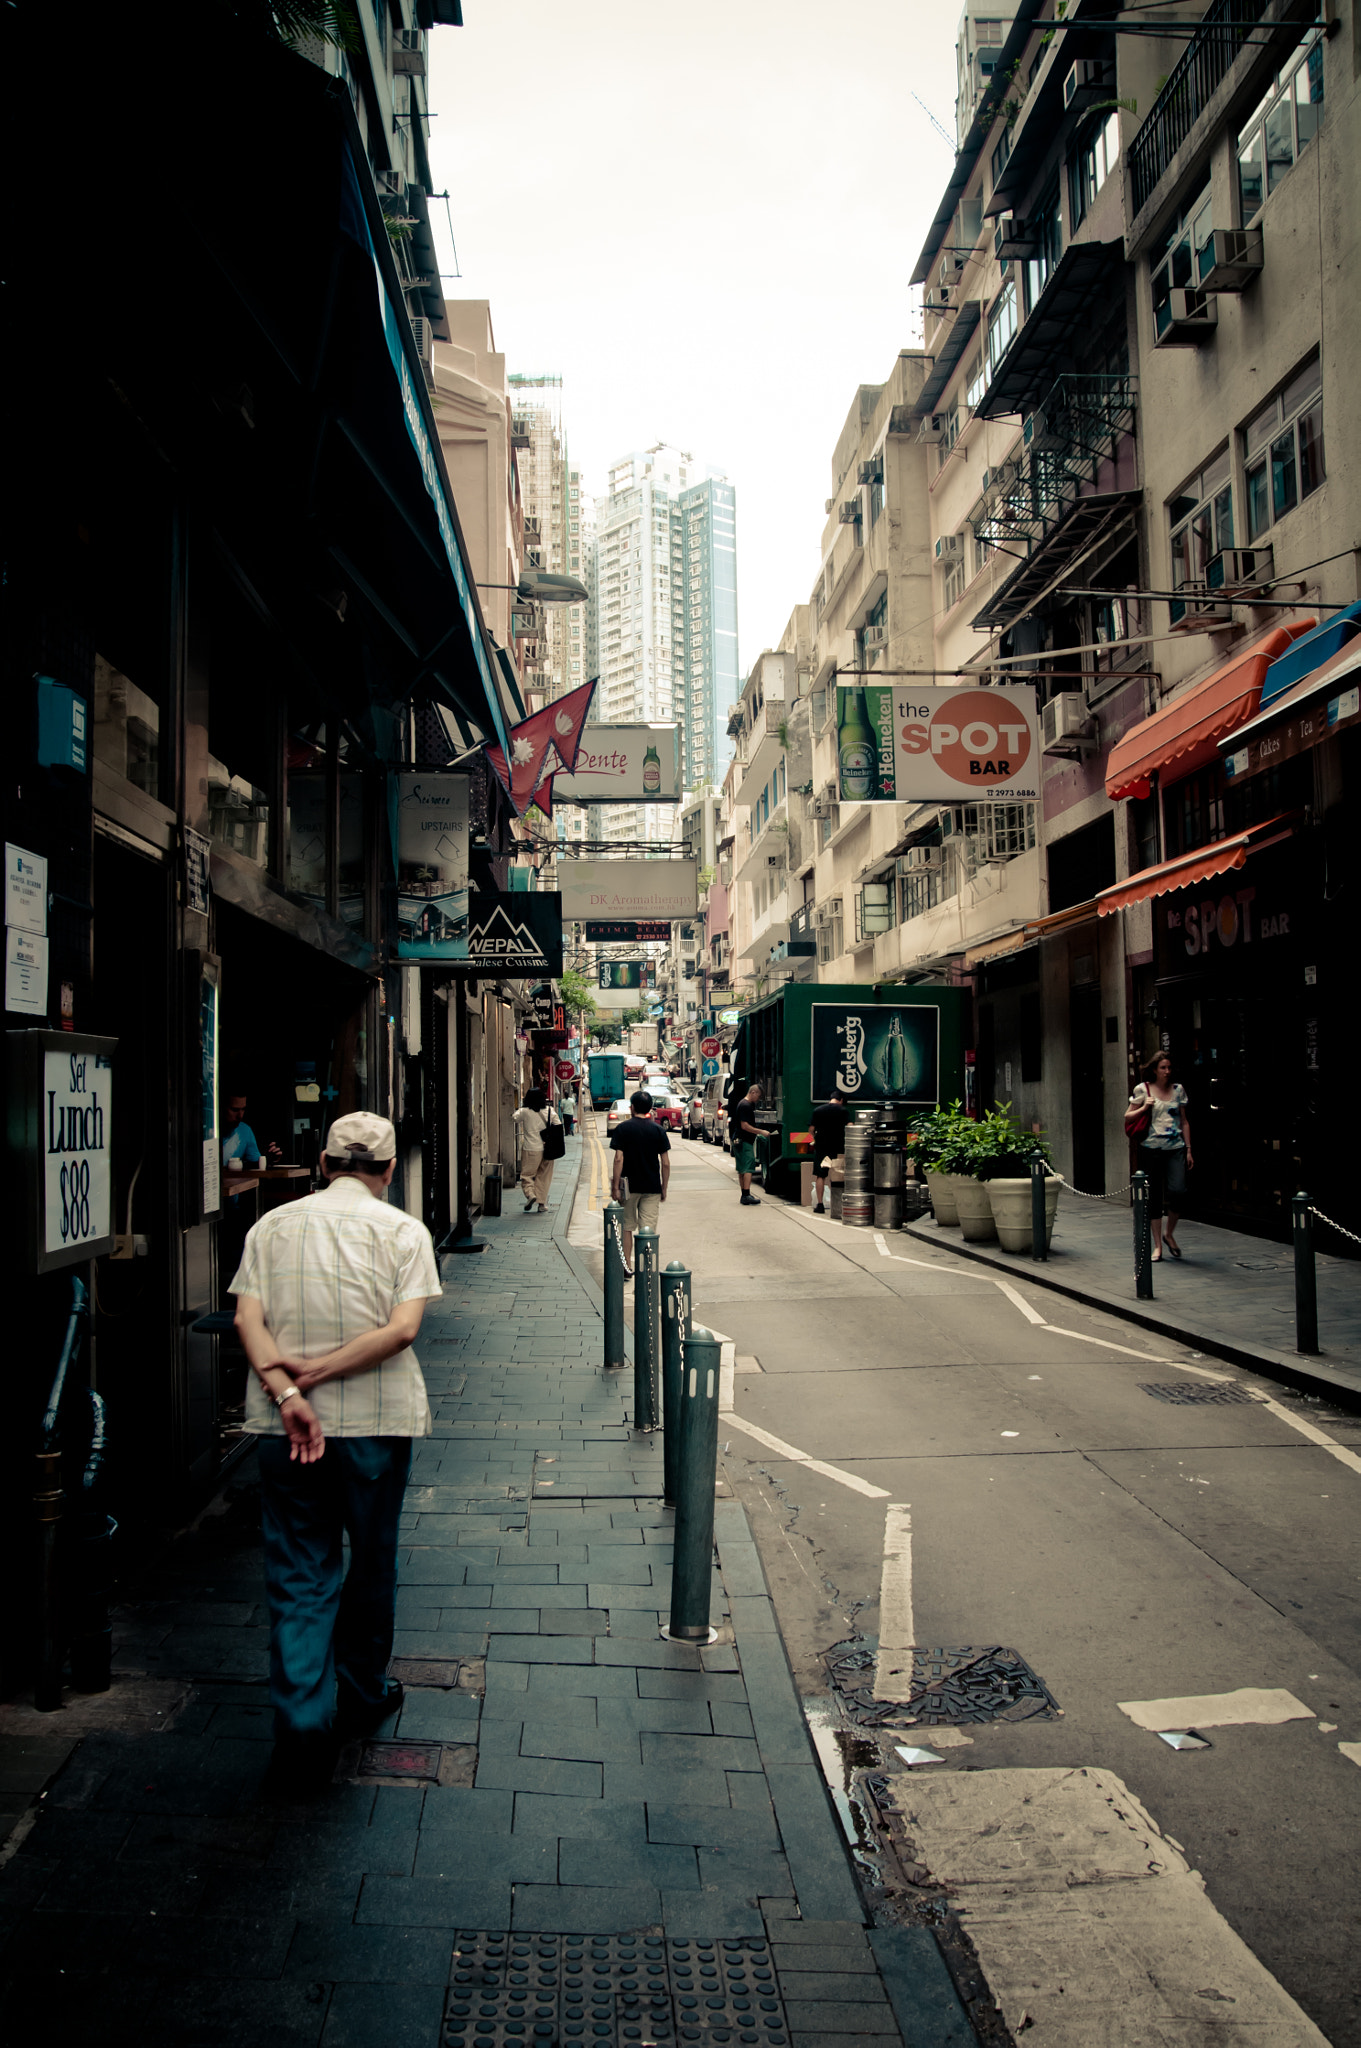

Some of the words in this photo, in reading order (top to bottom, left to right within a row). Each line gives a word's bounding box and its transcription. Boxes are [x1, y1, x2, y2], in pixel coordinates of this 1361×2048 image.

[898, 702, 930, 718] the
[876, 692, 894, 775] Heineken
[901, 721, 1027, 755] SPOT
[1260, 738, 1280, 758] Cakes
[1299, 719, 1313, 738] Tea
[577, 748, 629, 769] Dente
[969, 760, 1010, 775] BAR
[421, 821, 463, 832] UPSTAIRS
[590, 894, 608, 905] DK
[612, 893, 694, 907] Aromatherapy
[1184, 885, 1257, 956] SPOT
[1260, 912, 1291, 940] BAR
[469, 938, 534, 953] NEPAL
[505, 956, 549, 967] Cuisine
[836, 1016, 868, 1094] Carlsberg
[70, 1052, 87, 1093] Set
[47, 1091, 104, 1153] Lunch
[60, 1159, 90, 1243] $88
